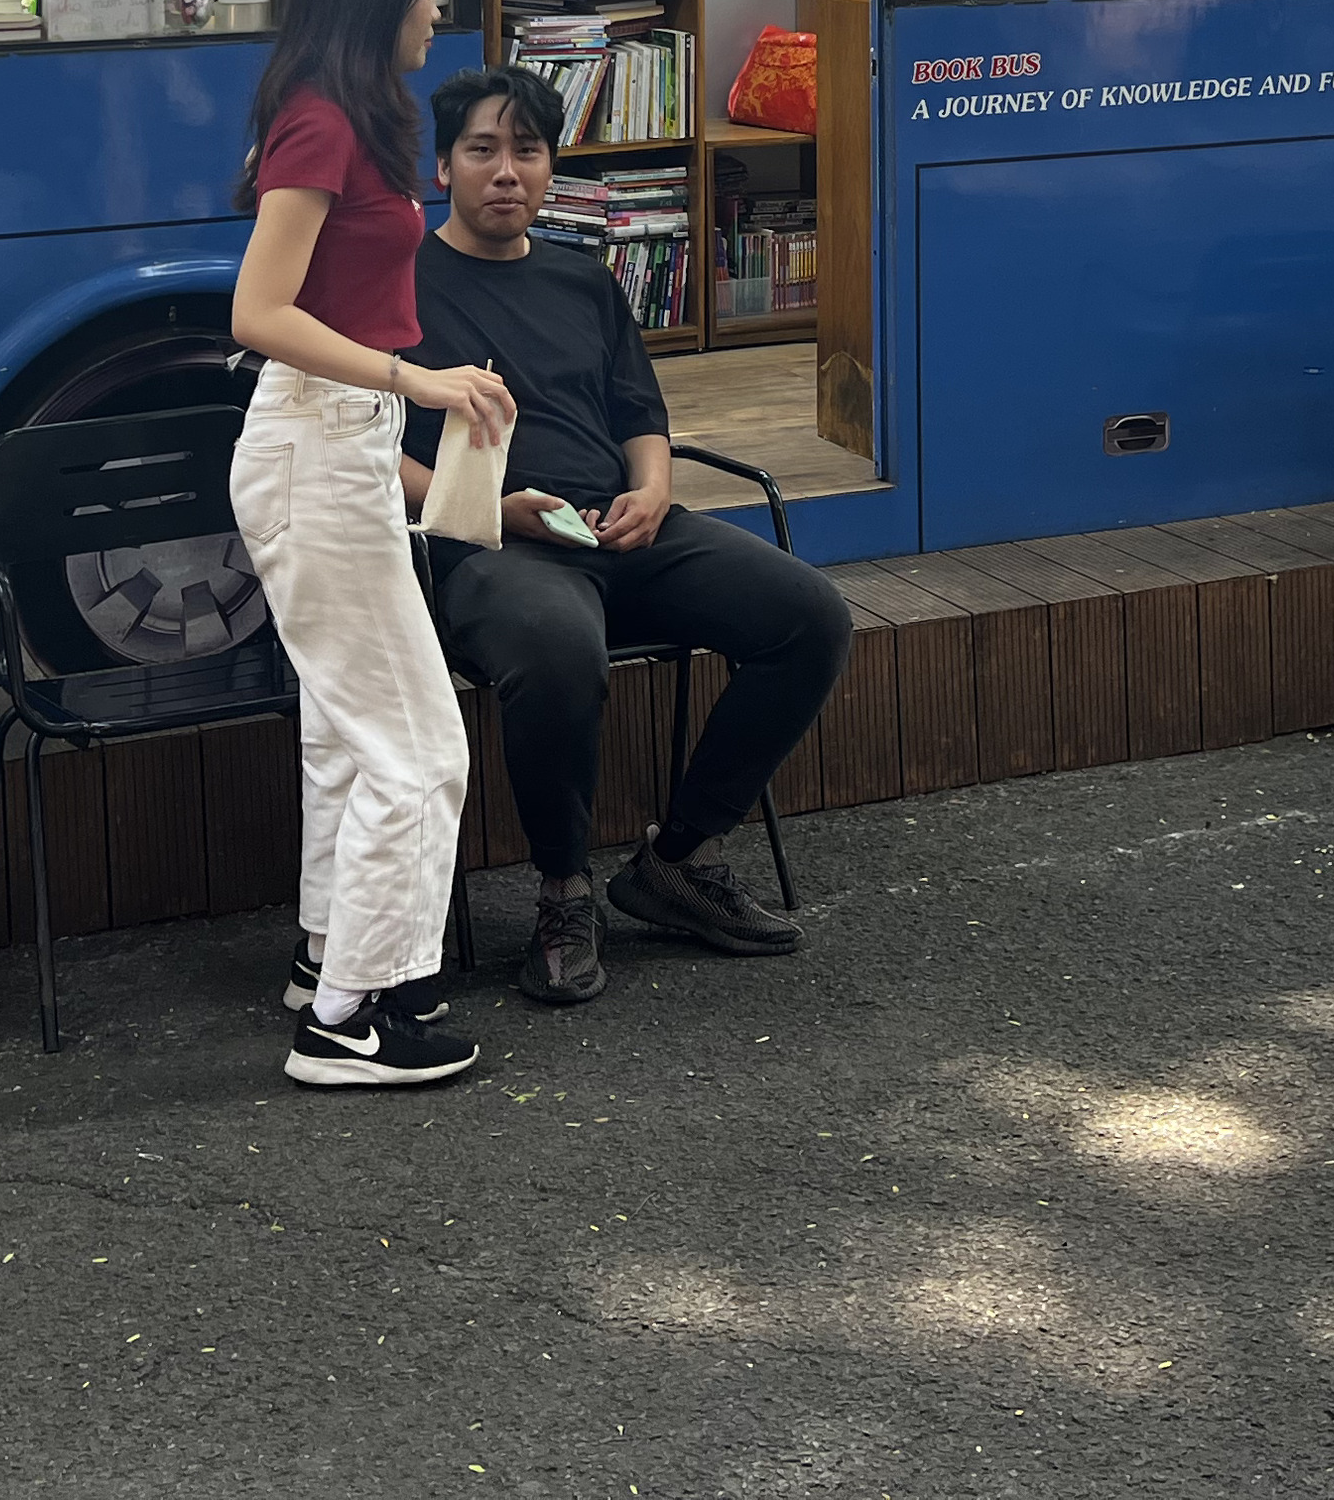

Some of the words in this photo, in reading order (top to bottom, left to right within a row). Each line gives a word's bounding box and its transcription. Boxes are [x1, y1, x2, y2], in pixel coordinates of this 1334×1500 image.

[911, 56, 982, 85] BOOK
[989, 52, 1041, 78] BUS
[911, 98, 930, 121] A
[937, 90, 1051, 119] JOURNEY
[1061, 88, 1094, 110] OF
[1100, 77, 1253, 107] KNOWLEDGE
[1259, 72, 1311, 97] AND
